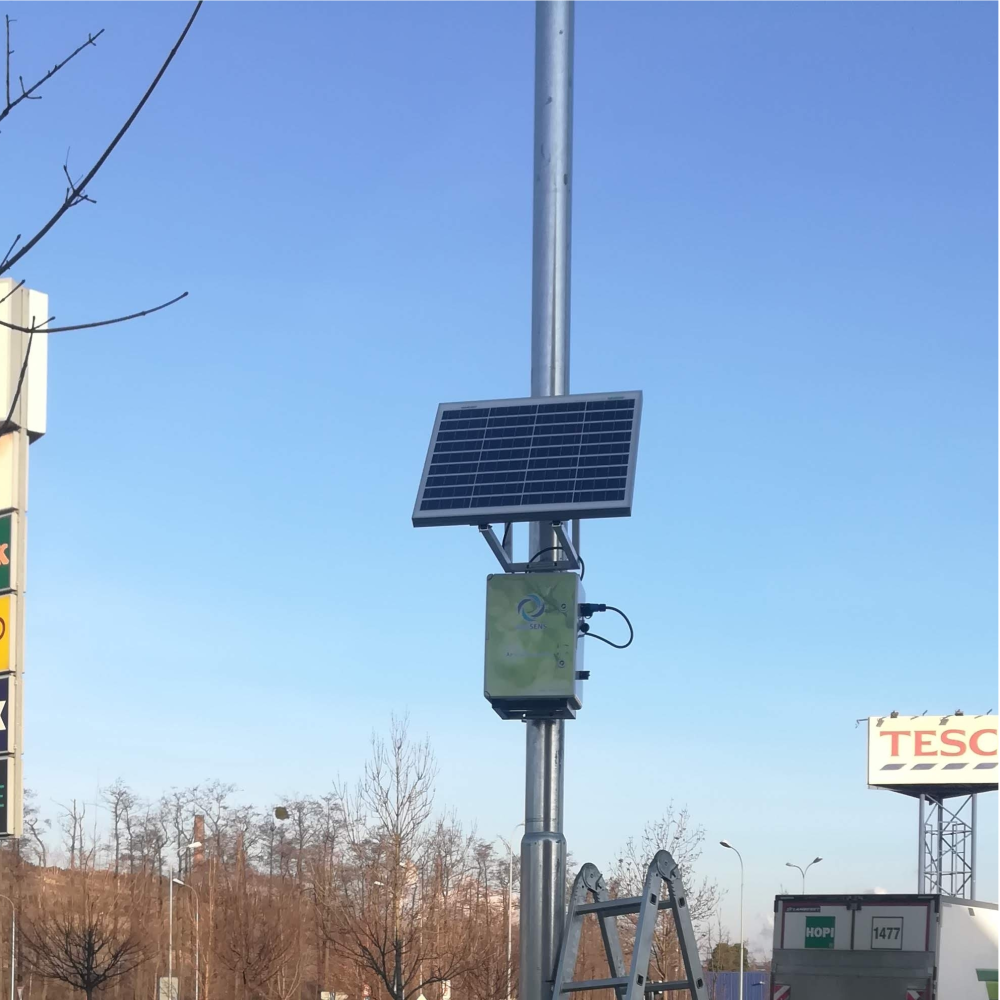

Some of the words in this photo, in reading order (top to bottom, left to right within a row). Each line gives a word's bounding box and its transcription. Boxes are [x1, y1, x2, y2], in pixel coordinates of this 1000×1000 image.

[880, 729, 997, 757] TESC
[806, 927, 834, 938] HOPI
[873, 927, 900, 940] 1477
